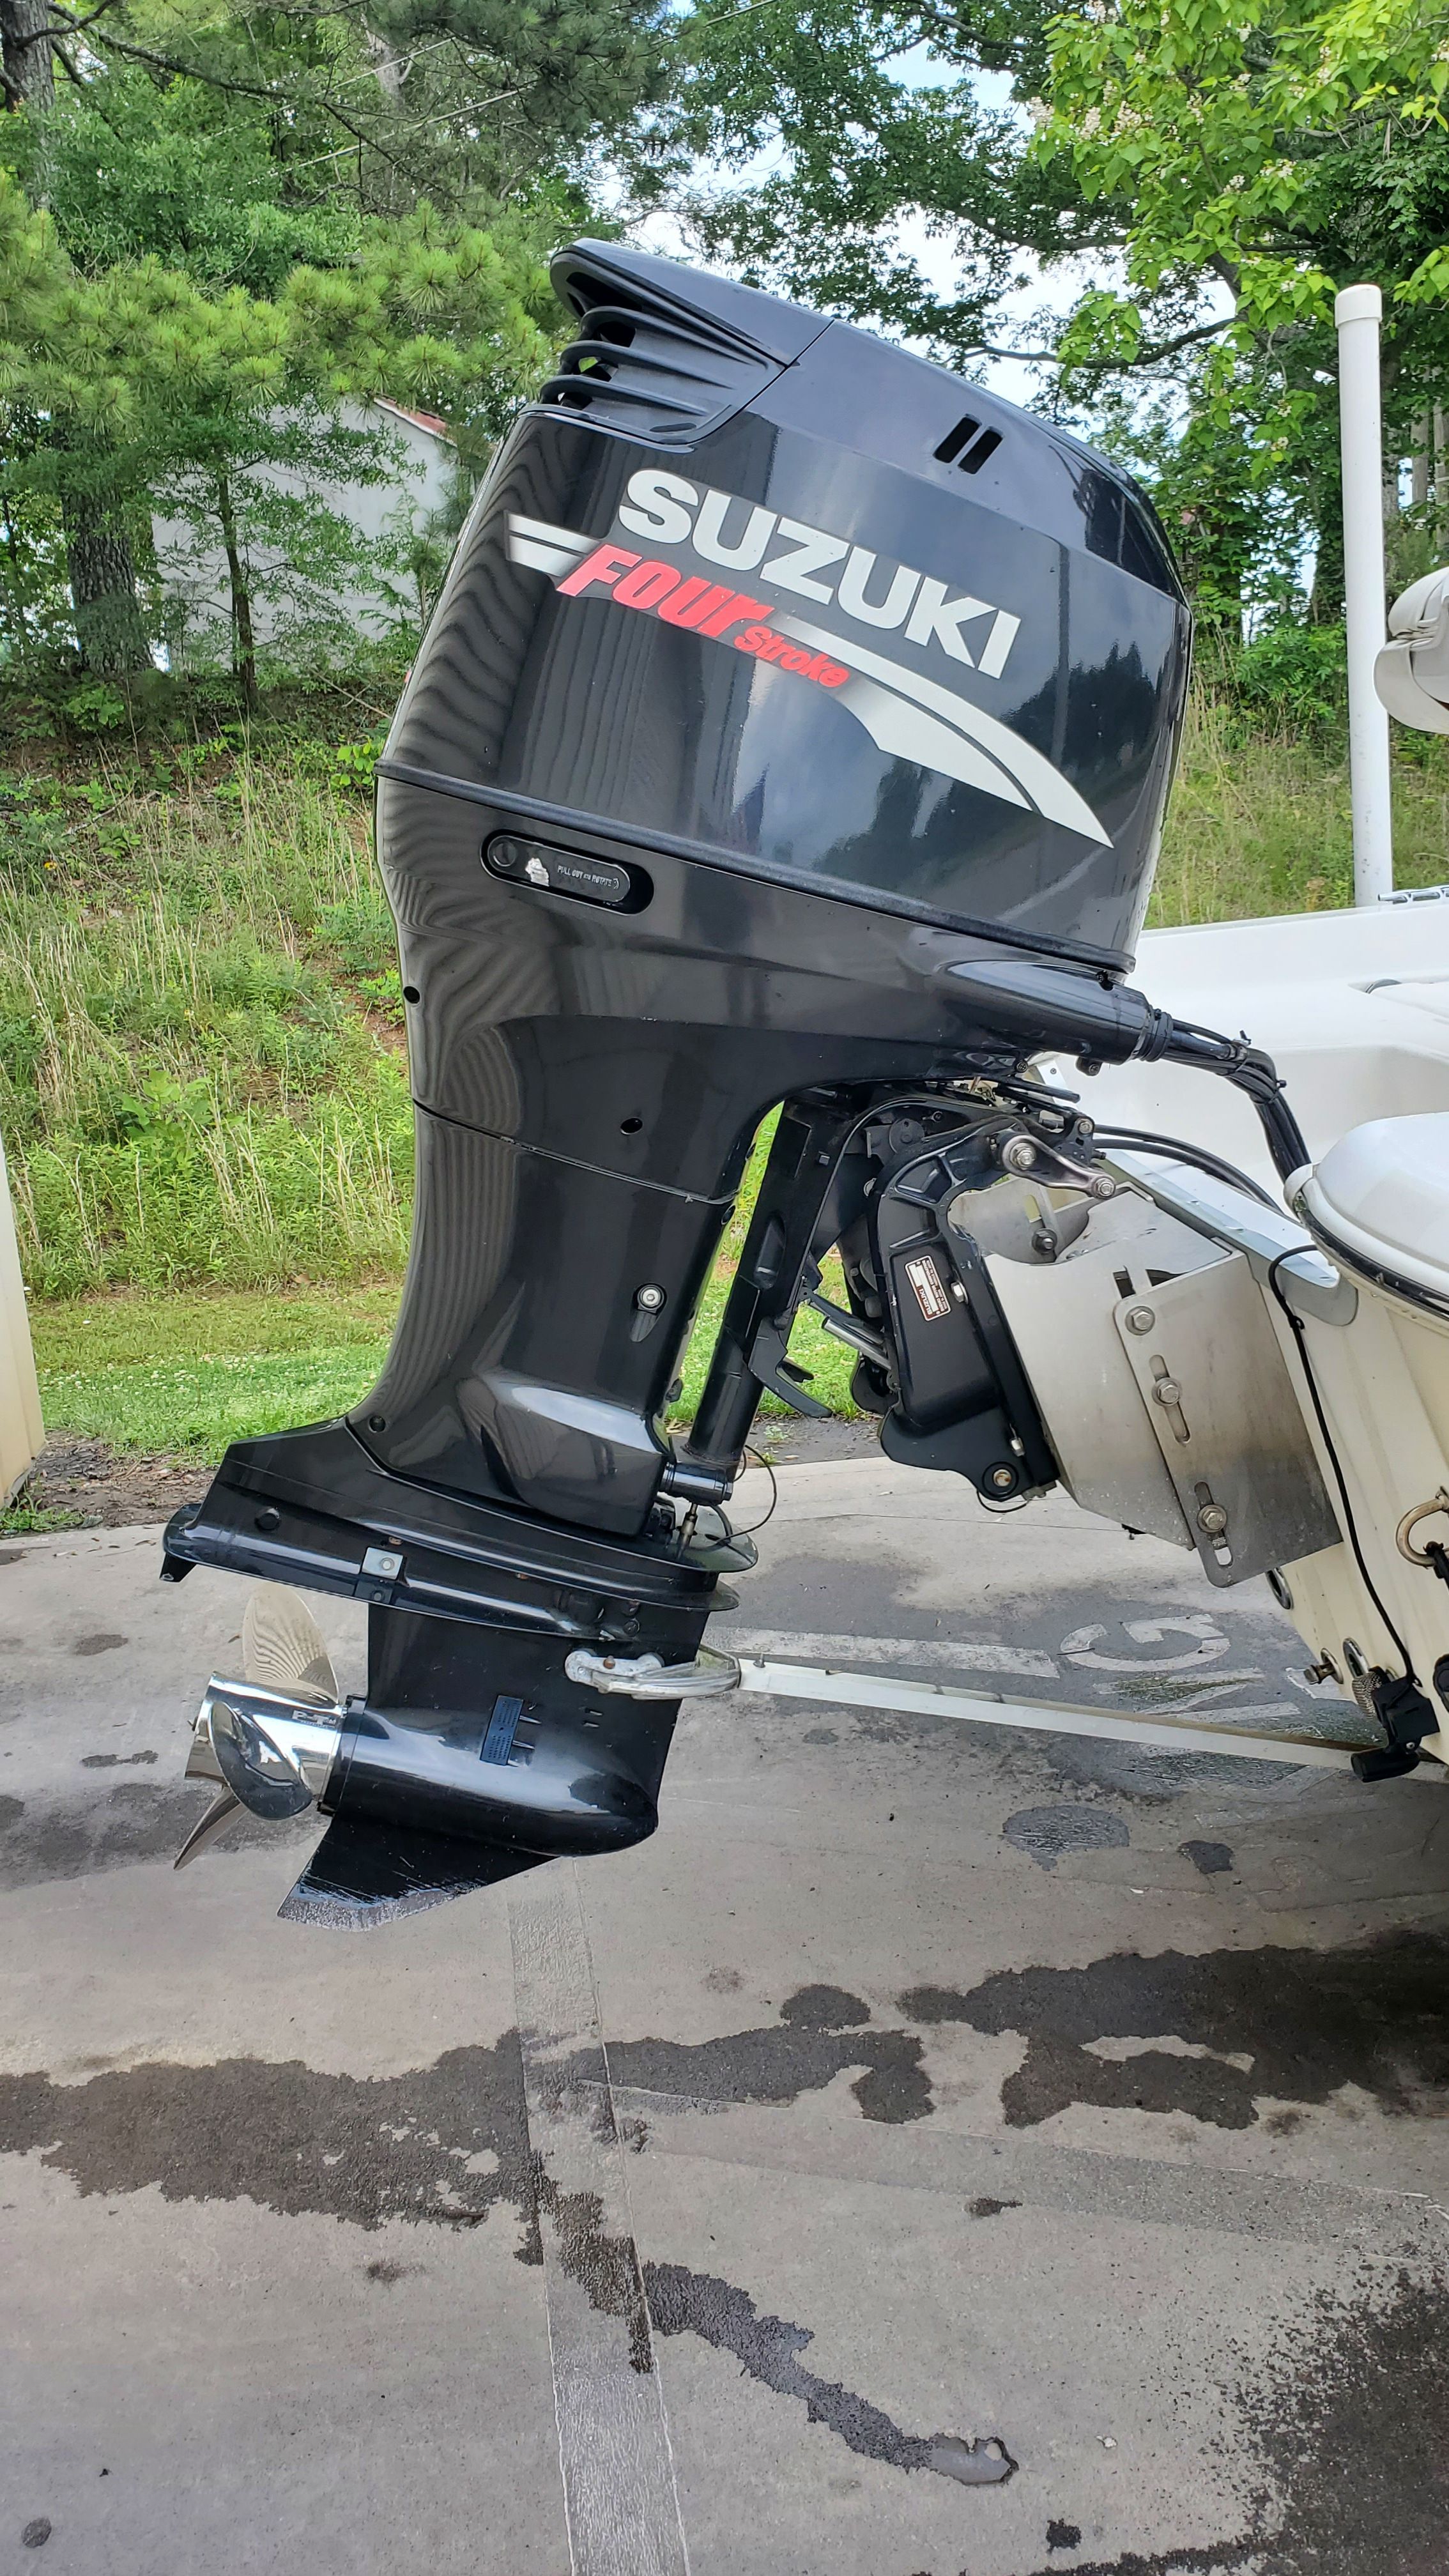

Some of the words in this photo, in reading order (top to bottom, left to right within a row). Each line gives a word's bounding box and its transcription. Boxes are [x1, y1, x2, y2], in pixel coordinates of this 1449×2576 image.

[618, 469, 1022, 680] SUZUKI
[733, 625, 850, 688] Stroke
[557, 865, 571, 876] PULL
[572, 870, 583, 879] OUT
[592, 874, 612, 887] ROTATE
[919, 1288, 933, 1315] SUZUKI
